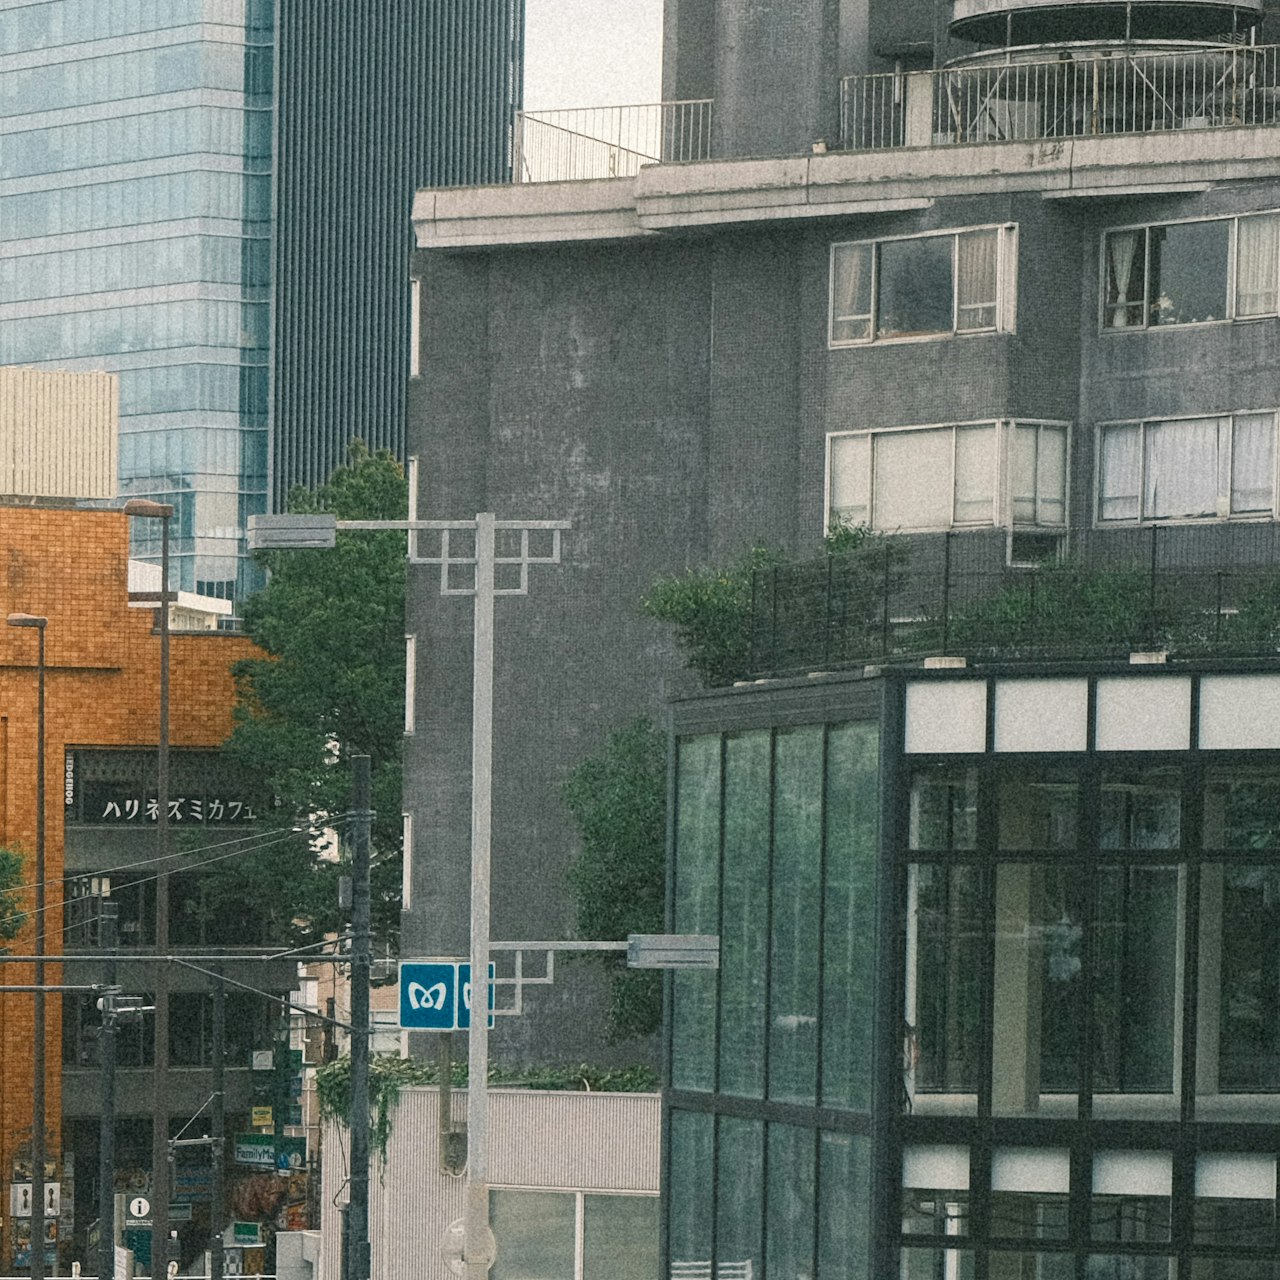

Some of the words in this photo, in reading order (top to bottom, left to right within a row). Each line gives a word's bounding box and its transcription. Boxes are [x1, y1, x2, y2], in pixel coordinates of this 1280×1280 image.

[102, 798, 257, 821] ハリネズミカフェ
